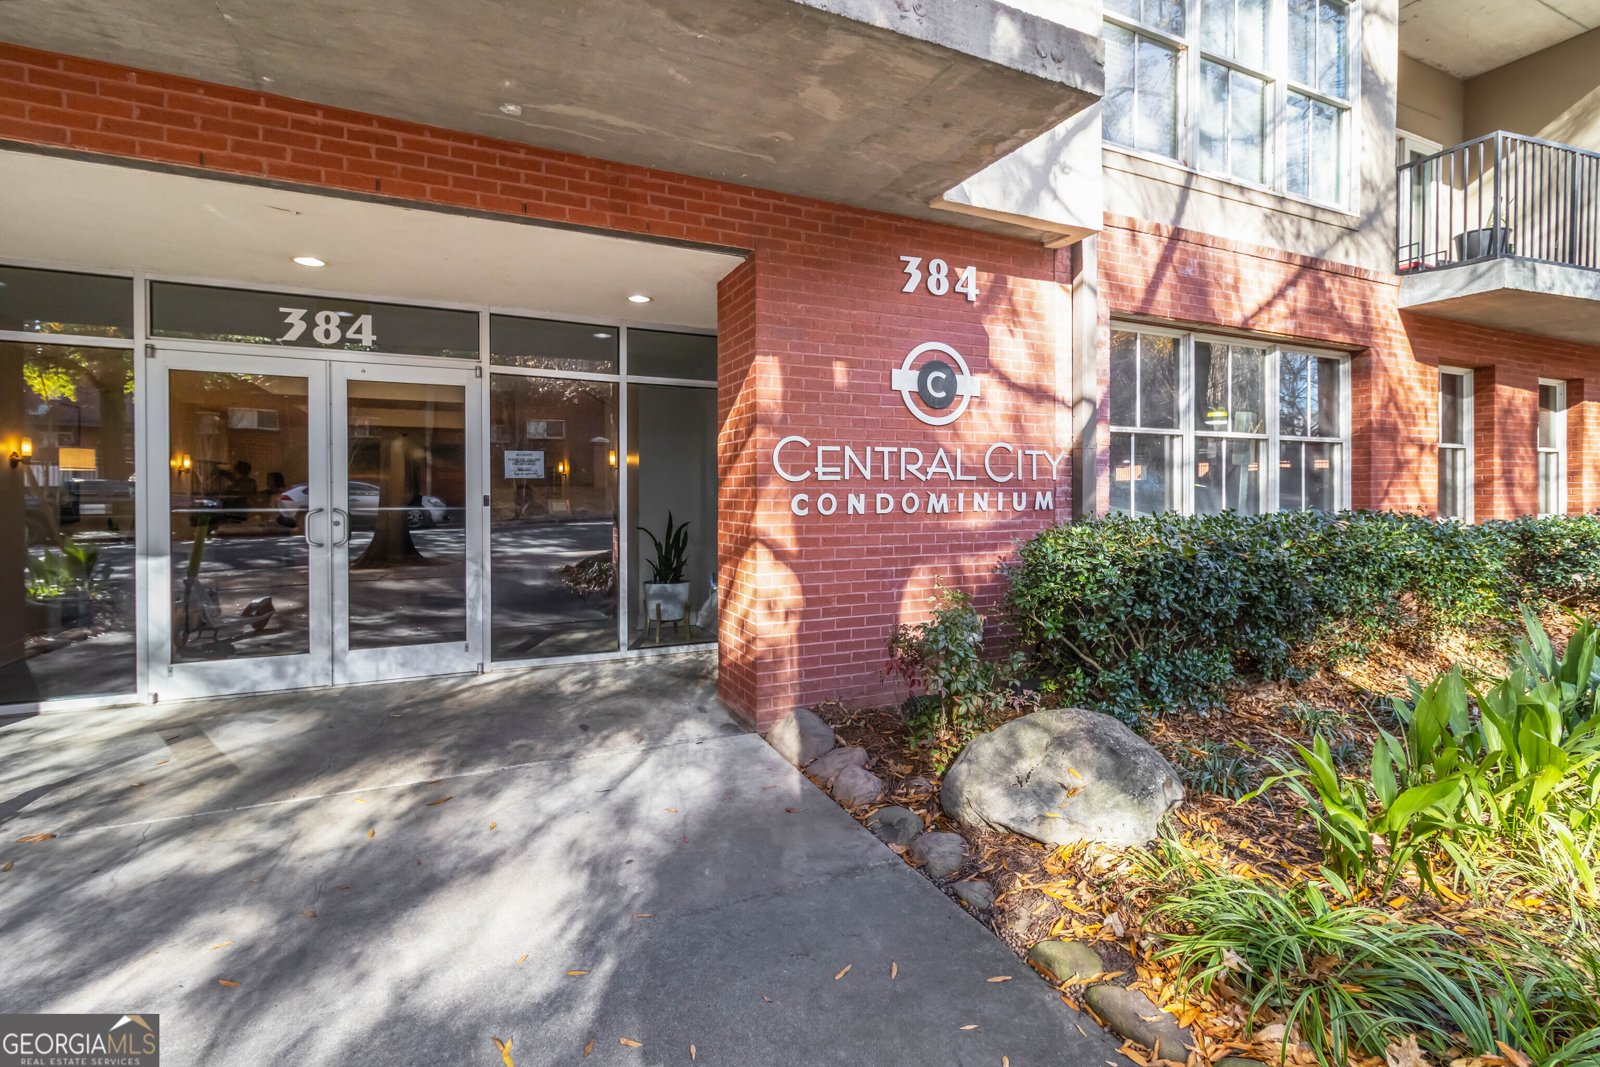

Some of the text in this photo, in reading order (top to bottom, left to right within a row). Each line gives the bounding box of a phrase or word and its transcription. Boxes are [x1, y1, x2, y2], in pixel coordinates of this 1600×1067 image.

[899, 255, 980, 302] 384
[276, 307, 377, 347] 384
[926, 371, 947, 398] C
[772, 435, 1065, 483] CENTRAL CITY
[790, 491, 1054, 517] CONDOMINIUM
